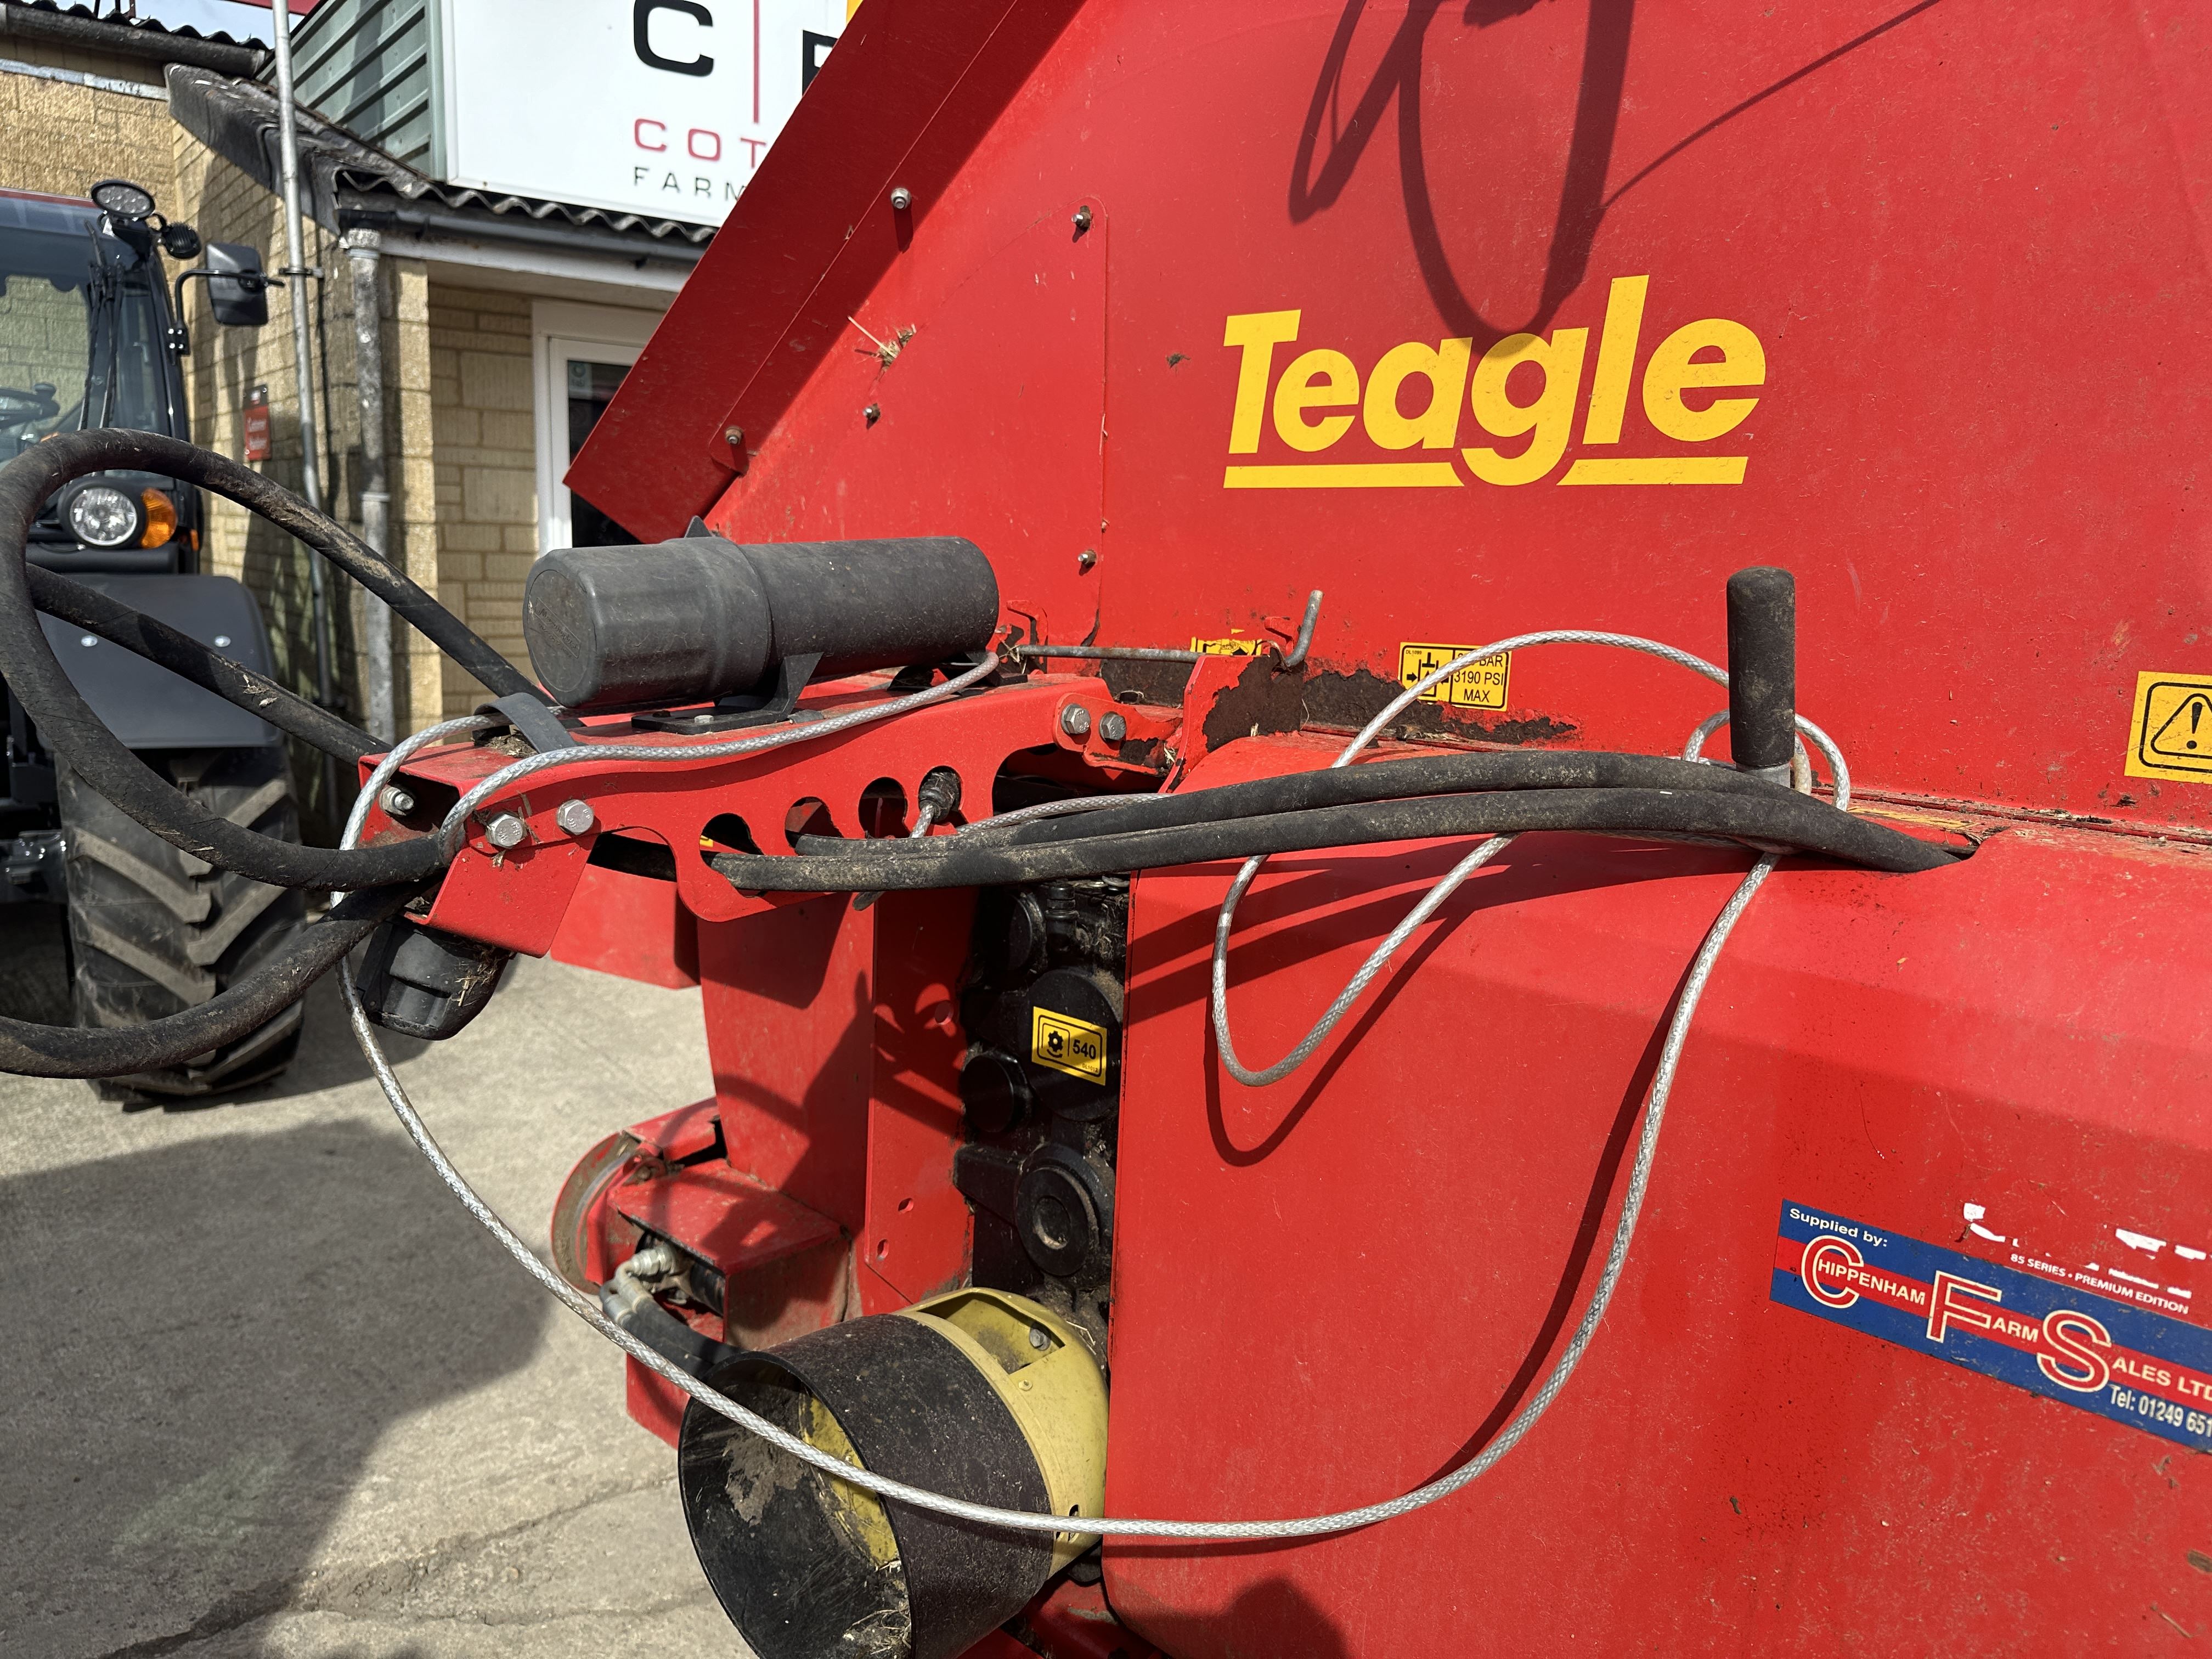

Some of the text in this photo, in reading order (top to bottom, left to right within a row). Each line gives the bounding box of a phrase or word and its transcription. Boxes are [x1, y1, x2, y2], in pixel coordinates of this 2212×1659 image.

[1223, 275, 1766, 487] Teagle
[1454, 671, 1503, 686] 3190 PSI
[1480, 655, 1503, 667] BAR
[1464, 689, 1490, 702] MAX
[1073, 1039, 1096, 1059] 540
[1790, 1208, 1888, 1246] Supplied by:
[2010, 1254, 2189, 1314] 85 SERIES PREMIUM EDITION
[1801, 1235, 1926, 1308] CHIPPENHAM
[1926, 1270, 2039, 1344] FARM
[2036, 1310, 2171, 1392] SALES
[2111, 1385, 2212, 1437] Tel: 01249 651
